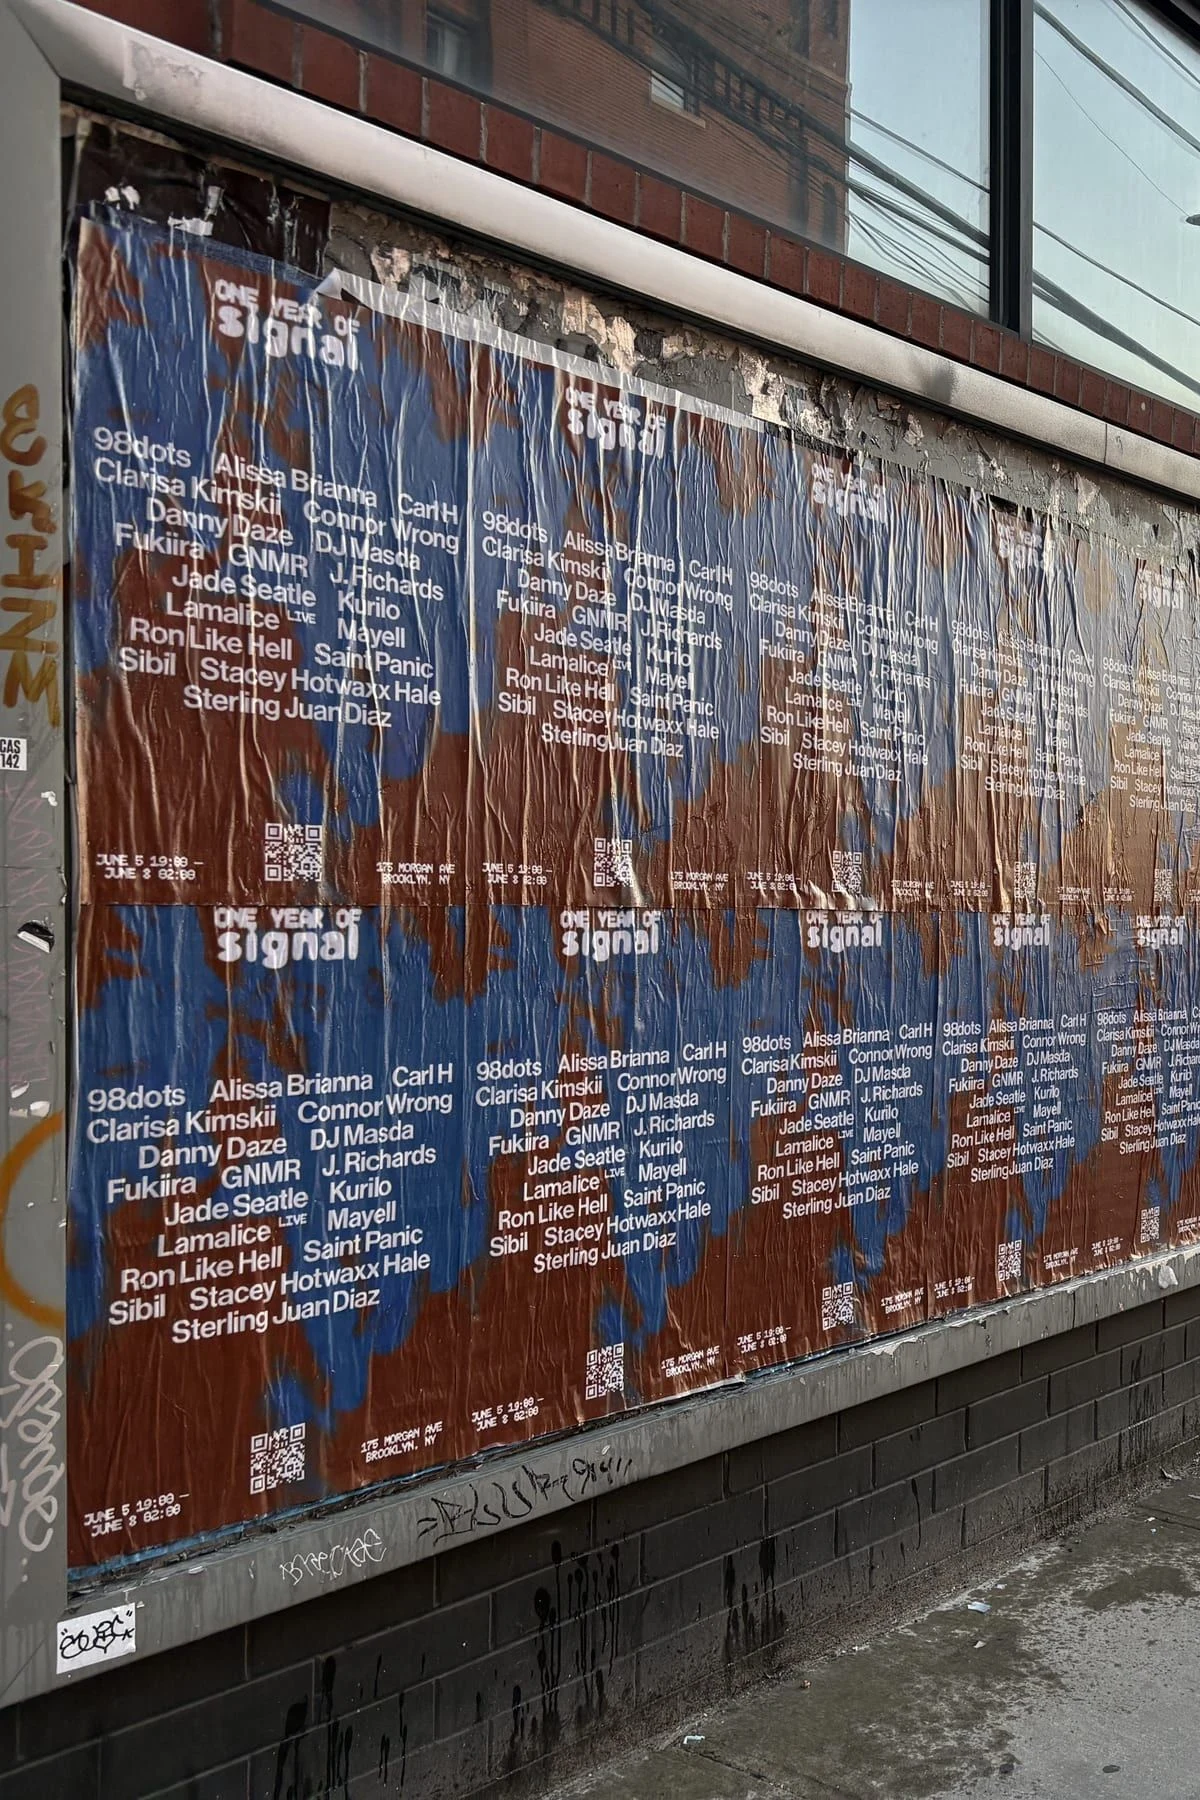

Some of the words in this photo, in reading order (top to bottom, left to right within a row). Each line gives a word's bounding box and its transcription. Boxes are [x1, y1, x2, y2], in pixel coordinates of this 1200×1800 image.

[215, 279, 259, 307] ONE
[272, 297, 322, 329] YEAR
[334, 315, 361, 336] OF
[218, 305, 359, 371] signal
[94, 427, 191, 468] 98dots
[214, 452, 287, 488] Alissa
[291, 468, 378, 507] Brianna
[396, 491, 439, 520] Carl
[442, 500, 459, 524] H
[94, 458, 186, 497] Clarisa
[191, 476, 281, 516] Kimskii
[302, 499, 389, 536] Connor
[390, 516, 459, 554] Wrong
[130, 616, 184, 647] Ron
[189, 625, 243, 655] Like
[247, 633, 291, 661] Hell
[312, 642, 371, 671] Saint
[374, 650, 434, 679] Panic
[182, 684, 279, 724] Sterling
[282, 697, 341, 725] Juan
[343, 702, 392, 729] Diaz
[499, 689, 537, 715] Sibil
[552, 698, 611, 729] Stacey
[613, 707, 683, 736] Hotwaxx
[685, 717, 720, 741] Hale
[398, 863, 434, 874] MORGAN
[438, 864, 456, 874] AVE
[438, 875, 450, 885] NY
[215, 907, 258, 929] ONE
[271, 908, 324, 929] YEAR
[336, 908, 362, 929] OF
[560, 910, 590, 928] ONE
[598, 910, 635, 928] YEAR
[643, 910, 661, 928] OF
[806, 911, 828, 925] ONE
[835, 912, 863, 924] YEAR
[870, 912, 883, 924] OF
[807, 920, 882, 953] signal
[217, 923, 359, 969] signal
[562, 923, 660, 962] signal
[943, 1020, 980, 1037] 98dots
[987, 1018, 1017, 1033] Alissa
[1017, 1015, 1053, 1031] Brianna
[1060, 1012, 1079, 1028] Carl
[1079, 1011, 1087, 1026] H
[477, 1057, 542, 1080] 98dots
[556, 1051, 607, 1073] Alissa
[609, 1047, 670, 1068] Brianna
[682, 1039, 713, 1061] Carl
[715, 1038, 727, 1057] H
[742, 1055, 789, 1075] Clarisa
[790, 1048, 838, 1070] Kimskii
[848, 1046, 895, 1063] Connor
[895, 1041, 933, 1059] Wrong
[960, 1057, 993, 1073] Danny
[993, 1054, 1018, 1069] Daze
[1026, 1050, 1039, 1066] DJ
[1039, 1047, 1070, 1065] Masda
[87, 1084, 186, 1112] 98dots
[209, 1077, 283, 1103] Alissa
[287, 1072, 373, 1096] Brianna
[391, 1063, 434, 1088] Carl
[437, 1062, 453, 1084] H
[510, 1106, 566, 1127] Danny
[568, 1100, 610, 1121] Daze
[625, 1092, 647, 1114] DJ
[648, 1087, 699, 1111] Masda
[751, 1096, 797, 1117] Fukiira
[808, 1088, 850, 1110] GNMR
[860, 1085, 871, 1103] J.
[872, 1080, 923, 1102] Richards
[87, 1115, 180, 1144] Clarisa
[185, 1103, 276, 1135] Kimskii
[297, 1099, 384, 1123] Connor
[385, 1091, 453, 1115] Wrong
[138, 1143, 222, 1169] Danny
[227, 1136, 287, 1160] Daze
[310, 1125, 340, 1151] DJ
[343, 1119, 414, 1147] Masda
[107, 1172, 196, 1203] Fukiira
[220, 1158, 301, 1190] GNMR
[321, 1153, 340, 1177] J.
[344, 1143, 436, 1174] Richards
[522, 1174, 599, 1201] Lamalice
[603, 1166, 624, 1178] LIVE
[637, 1156, 687, 1183] Mayell
[164, 1197, 229, 1226] Jade
[232, 1186, 309, 1217] Seatle
[329, 1175, 392, 1203] Kurilo
[158, 1223, 271, 1257] Lamalice
[278, 1212, 307, 1227] LIVE
[327, 1199, 396, 1231] Mayell
[489, 1231, 528, 1257] Sibil
[543, 1222, 602, 1247] Stacey
[605, 1209, 675, 1236] Hotwaxx
[676, 1200, 711, 1223] Hale
[121, 1267, 175, 1293] Ron
[179, 1256, 234, 1283] Like
[238, 1245, 282, 1274] Hell
[303, 1233, 361, 1262] Saint
[364, 1224, 423, 1252] Panic
[108, 1293, 165, 1325] Sibil
[189, 1279, 276, 1311] Stacey
[280, 1261, 379, 1295] Hotwaxx
[383, 1249, 431, 1276] Hale
[172, 1310, 268, 1343] Sterling
[272, 1298, 330, 1324] Juan
[332, 1287, 380, 1313] Diaz
[361, 1438, 379, 1453] 175
[383, 1427, 421, 1447] MORGAN
[424, 1420, 443, 1435] AVE
[471, 1407, 493, 1423] JUNE
[476, 1416, 497, 1432] JUNE
[424, 1434, 437, 1447] NY
[83, 1508, 115, 1526] JUNE
[122, 1503, 130, 1516] 5
[91, 1519, 123, 1537] JUNE
[129, 1515, 137, 1527] 8
